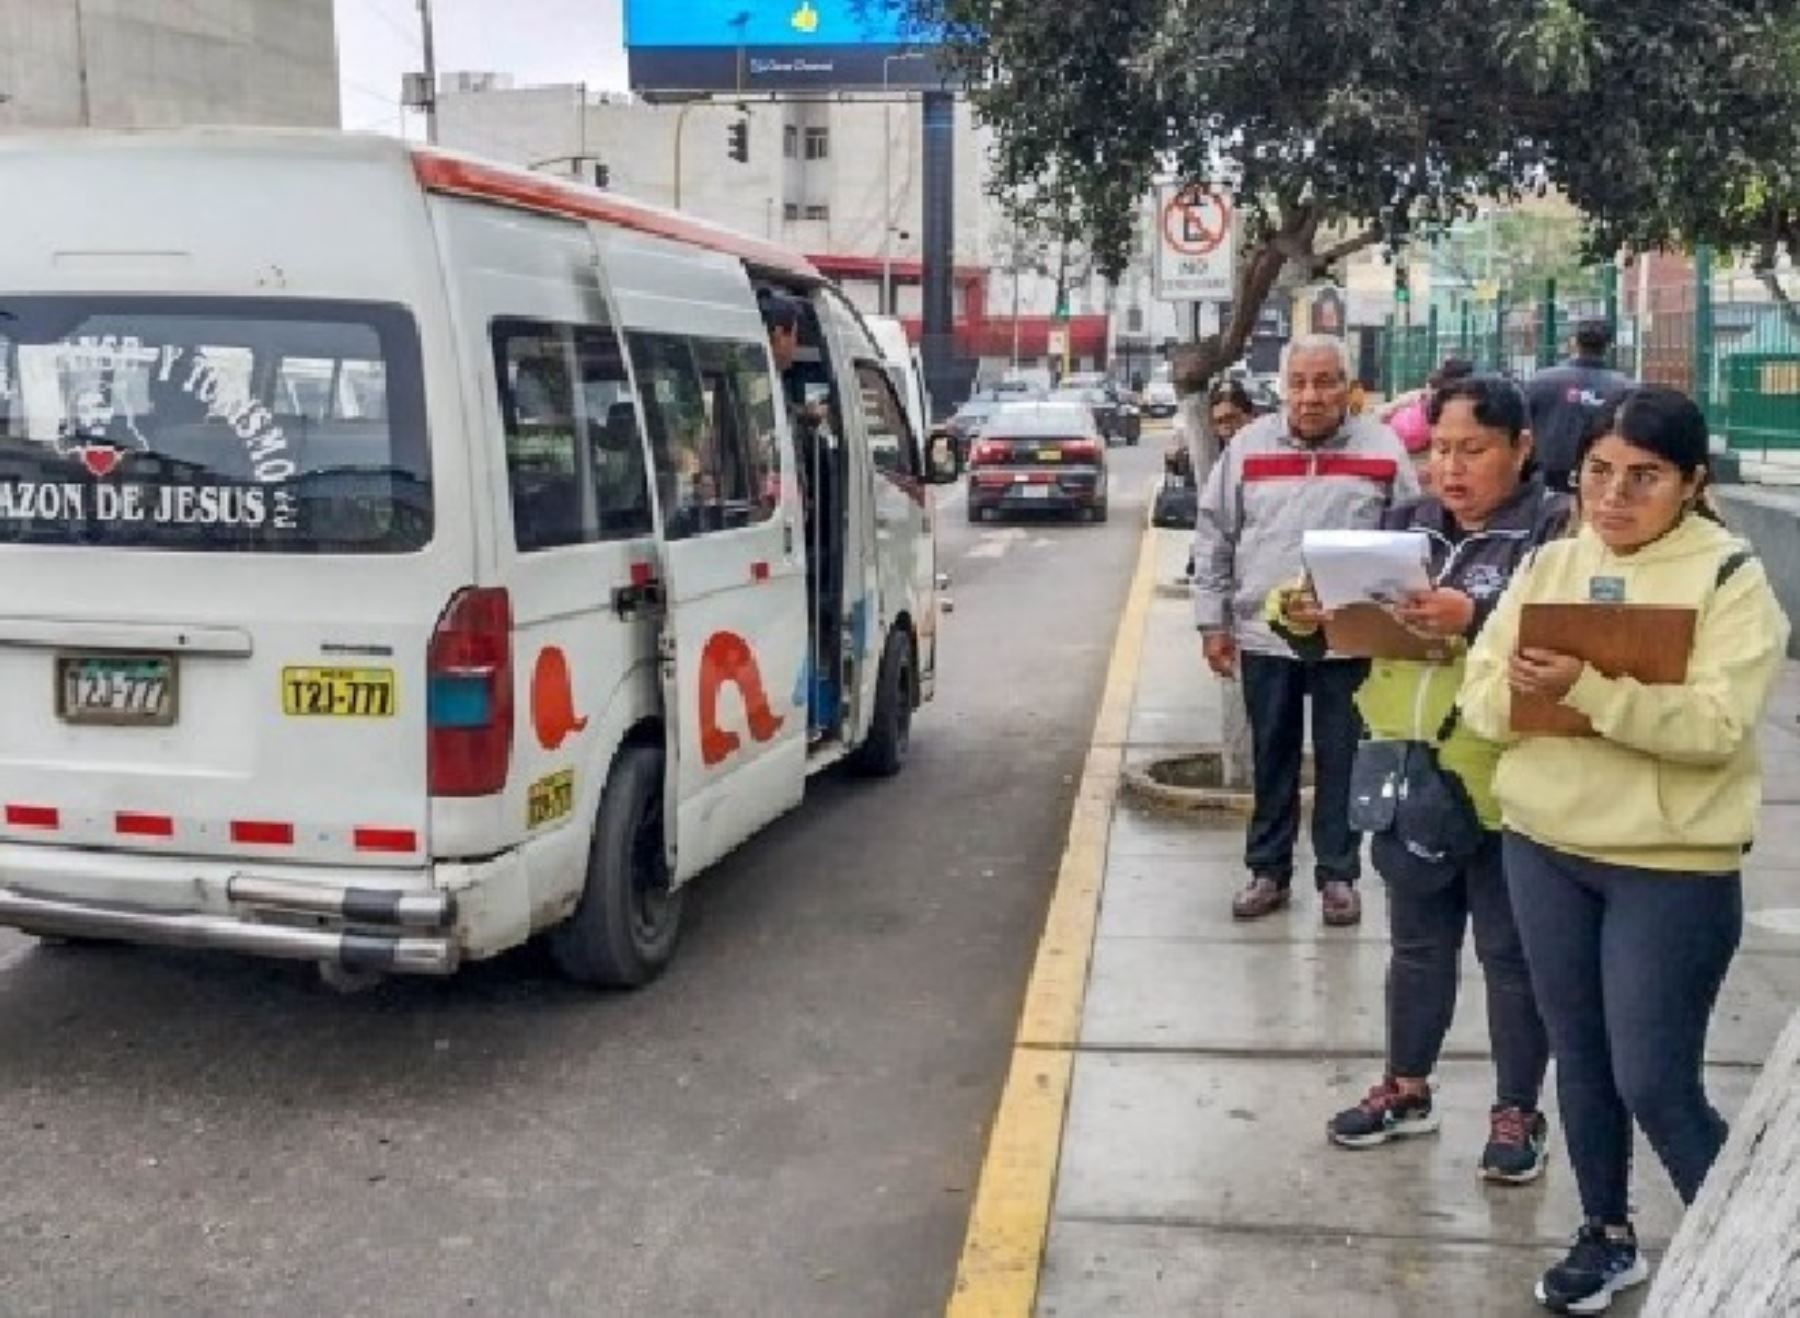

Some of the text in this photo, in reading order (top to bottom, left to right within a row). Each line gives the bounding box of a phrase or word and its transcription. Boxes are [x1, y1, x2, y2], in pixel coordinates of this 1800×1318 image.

[182, 345, 295, 482] TUISMO
[96, 484, 145, 521] DE
[154, 486, 266, 525] JESUS
[288, 682, 390, 715] T2J-777
